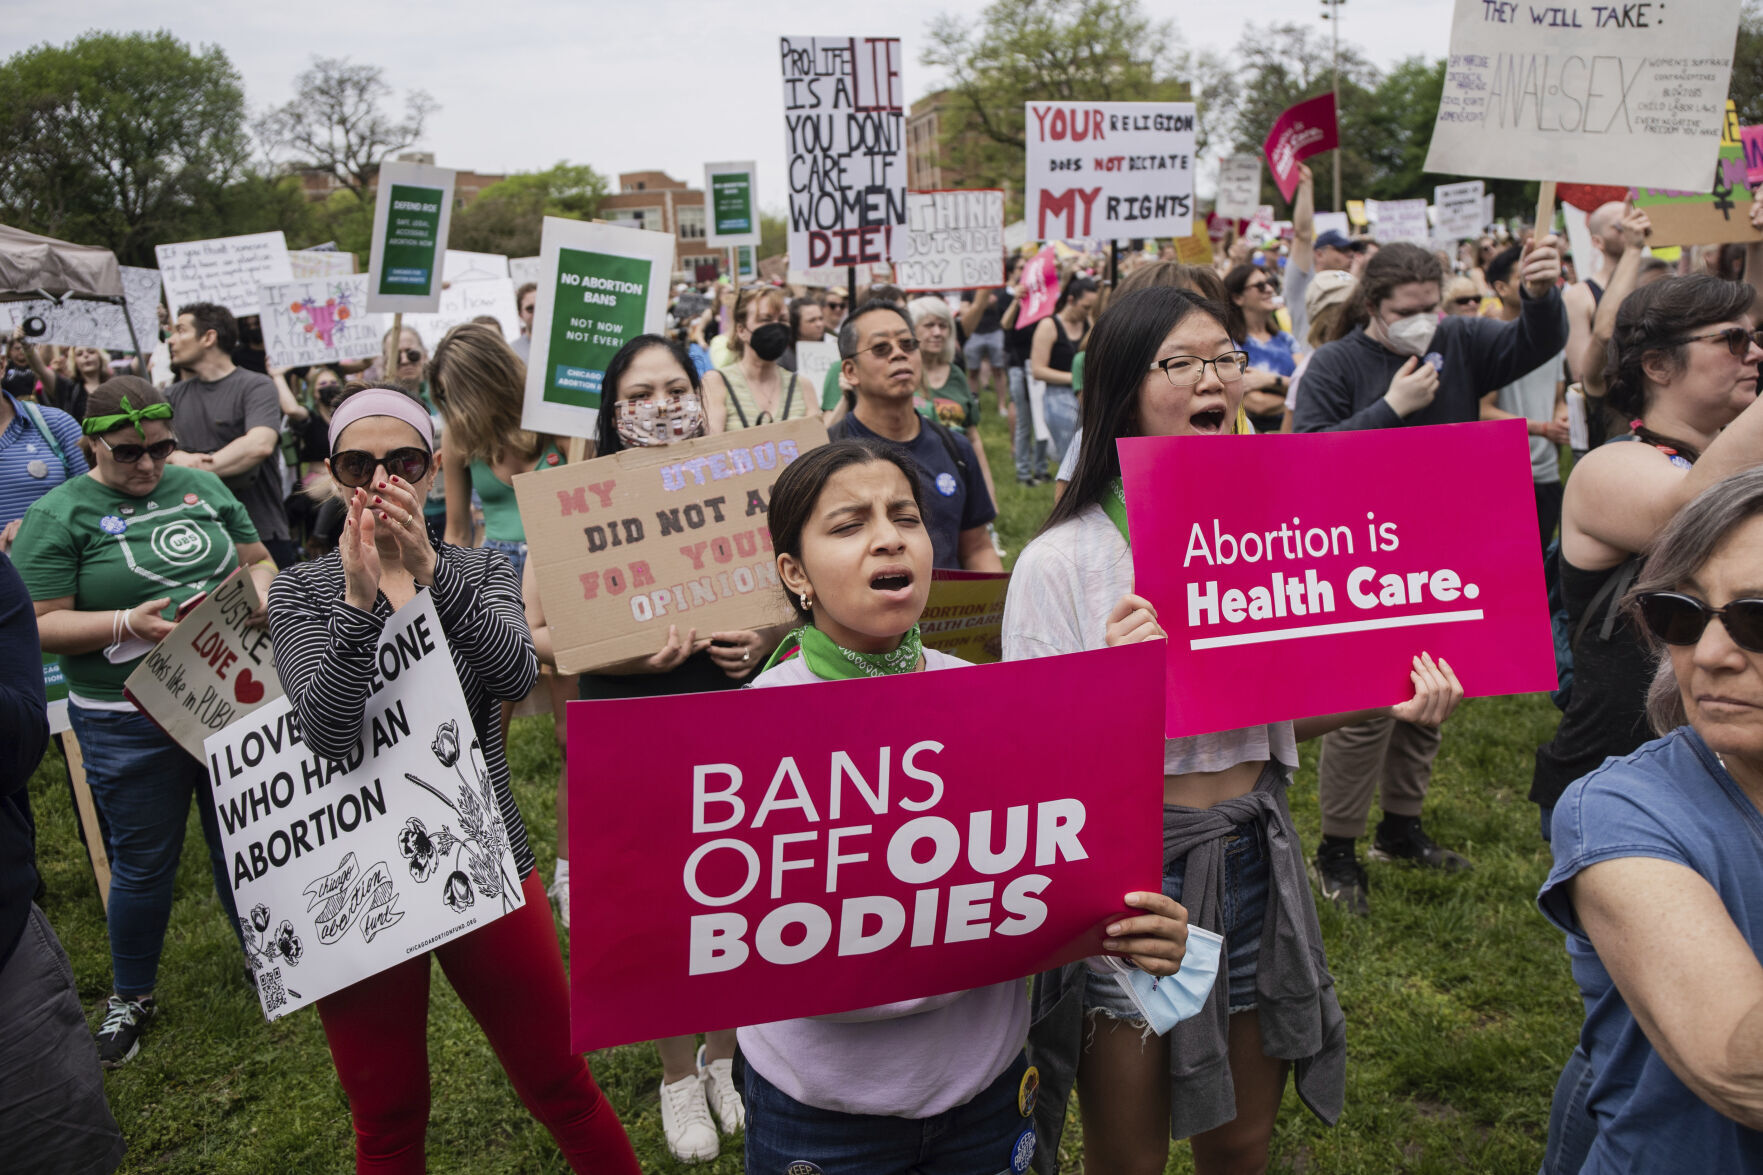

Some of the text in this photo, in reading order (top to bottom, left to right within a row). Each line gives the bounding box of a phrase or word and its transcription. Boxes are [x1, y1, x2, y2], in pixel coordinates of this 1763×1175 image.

[1482, 0, 1518, 23] THEY
[1530, 6, 1582, 28] WILL
[785, 37, 903, 113] IS A LIE
[786, 113, 833, 154] YOU
[1032, 106, 1194, 142] YOUR RELIGION
[789, 151, 897, 194] CARE IF
[1050, 155, 1188, 172] DOES NOT DICTATE
[789, 186, 907, 232] WOMEN
[907, 192, 1001, 232] THINK
[1038, 186, 1191, 240] MY RIGHTS
[809, 226, 892, 268] DIE!
[907, 230, 1000, 257] OUTSIDE
[561, 273, 643, 295] NO ABORTION
[900, 261, 949, 286] MY
[584, 292, 617, 306] BANS
[566, 331, 624, 347] NOT EVER!
[570, 317, 623, 334] NOT NOW
[558, 378, 595, 389] ABORTION
[566, 369, 602, 380] CHICAGO
[659, 440, 800, 492] UTERUS
[557, 479, 617, 517] MY
[584, 517, 646, 553] DID
[656, 496, 726, 537] NOT
[1183, 511, 1400, 568] Abortion is
[579, 560, 656, 600] FOR
[1186, 566, 1481, 627] Health Care.
[214, 579, 273, 666] JUSTICE
[919, 619, 963, 634] EALTH
[920, 603, 987, 619] BORTION
[191, 621, 239, 681] LOVE
[165, 662, 187, 699] like
[181, 687, 197, 711] in
[210, 612, 436, 788] I LOVE EONE
[219, 699, 412, 836] WHO HAD AN
[691, 739, 945, 834] BANS
[234, 777, 388, 891] ABORTION
[682, 798, 1090, 907] OFF OUR
[318, 864, 355, 898] chicago
[364, 905, 393, 936] fund
[405, 917, 478, 955] CHICAGOABORTIONFUND.ORG
[688, 873, 1053, 977] BODIES
